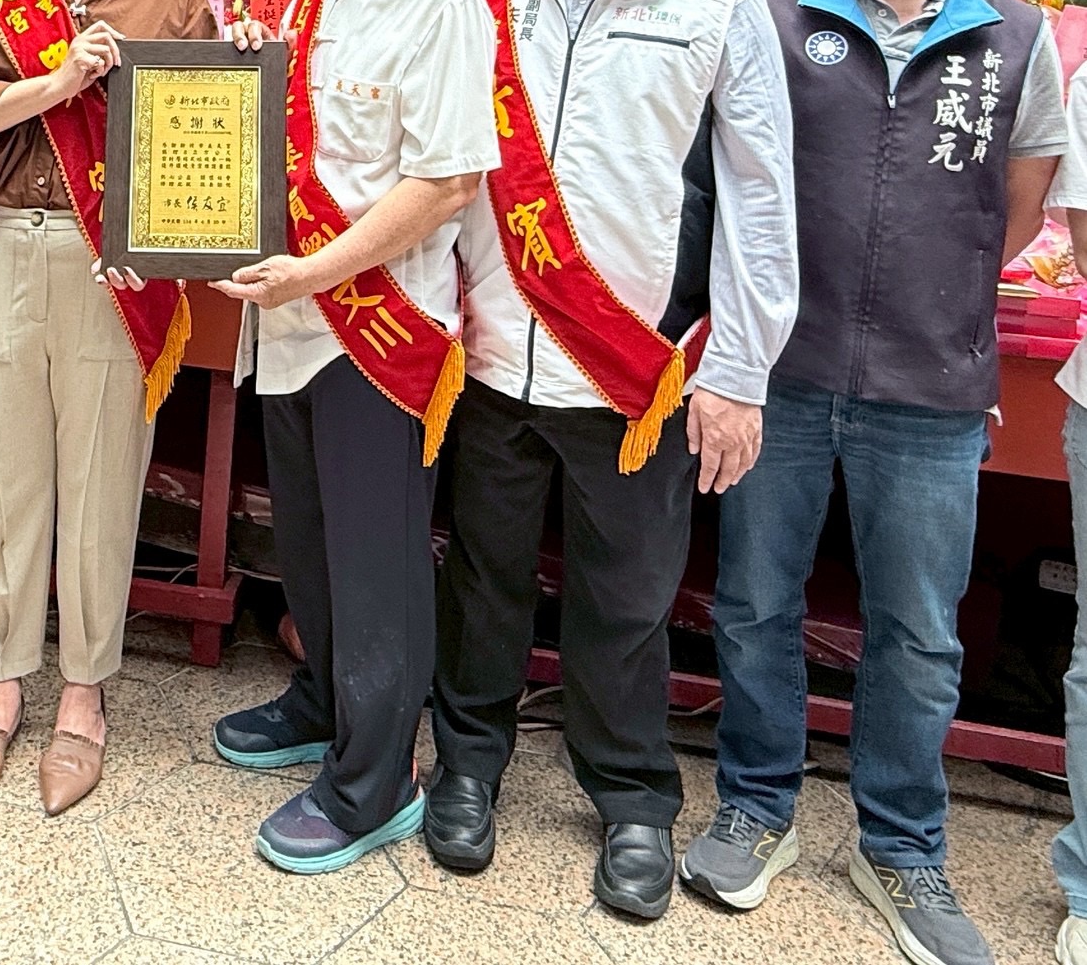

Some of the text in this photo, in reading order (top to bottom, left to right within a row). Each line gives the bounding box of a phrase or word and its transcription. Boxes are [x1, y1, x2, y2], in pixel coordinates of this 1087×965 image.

[179, 95, 230, 106] 新北市政府
[970, 49, 1003, 163] 新北市議員
[927, 55, 973, 172] 王威元
[170, 116, 225, 129] 感謝狀
[187, 195, 231, 212] 侯友宜
